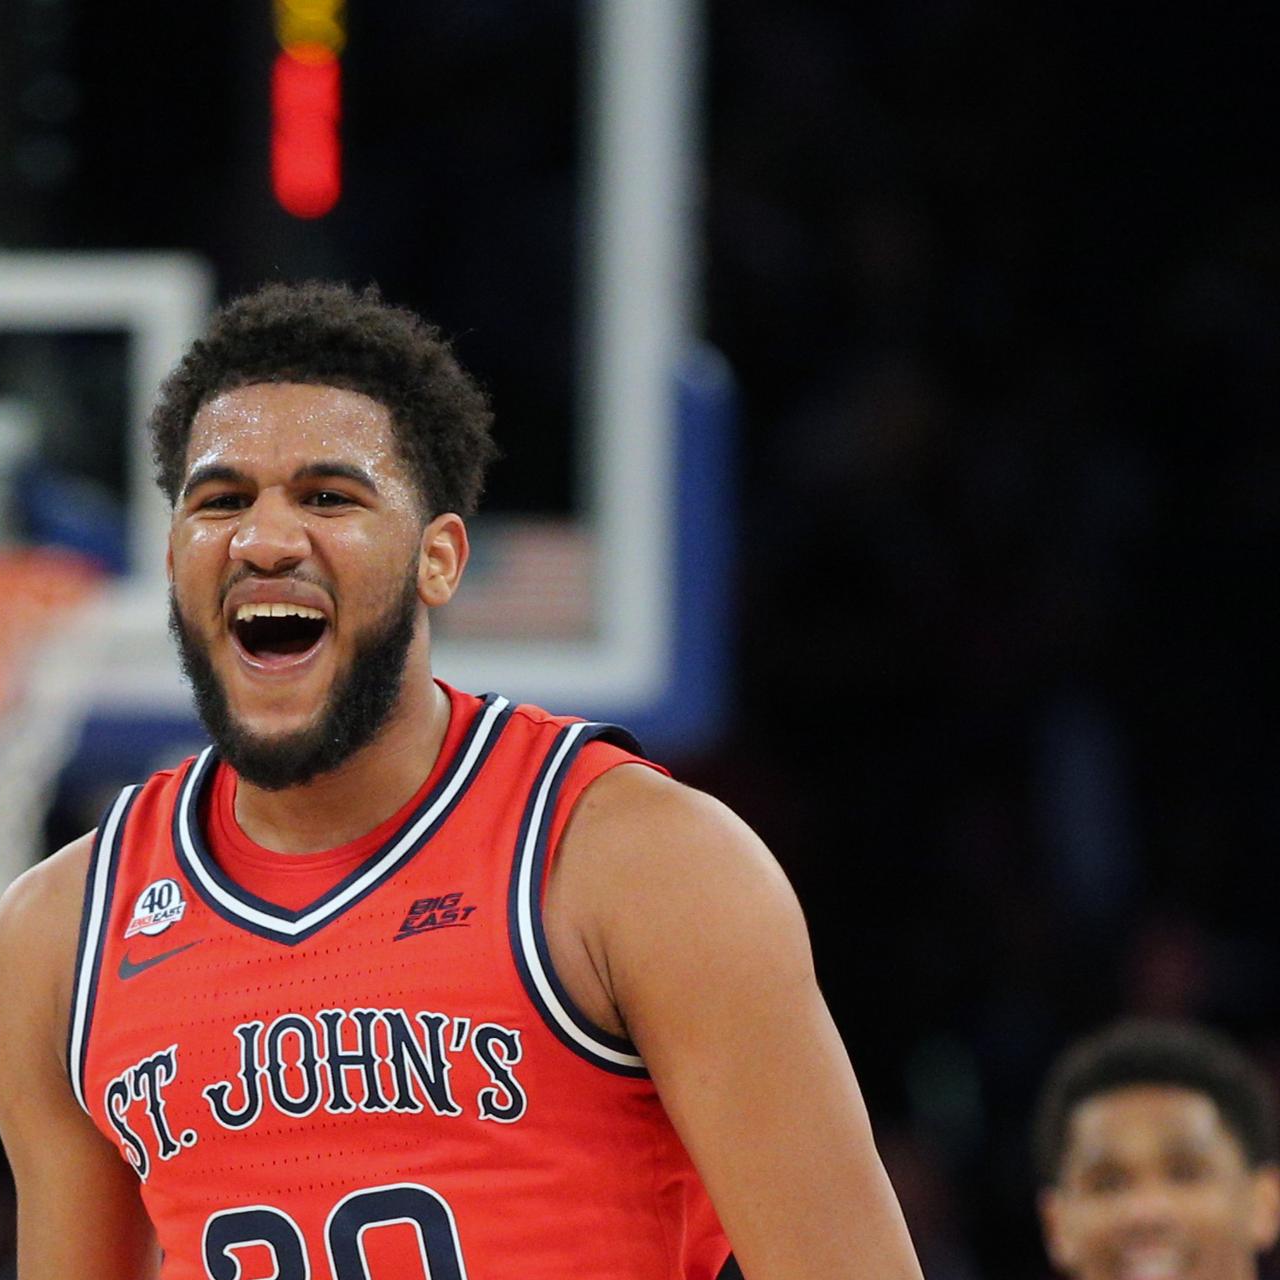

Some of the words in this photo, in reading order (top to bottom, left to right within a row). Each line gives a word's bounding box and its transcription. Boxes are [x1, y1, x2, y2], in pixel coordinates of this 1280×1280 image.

[141, 882, 173, 914] 40
[408, 892, 464, 915] BIG
[398, 906, 477, 932] EAST
[105, 1043, 198, 1182] ST.
[202, 1008, 527, 1130] JOHN'S
